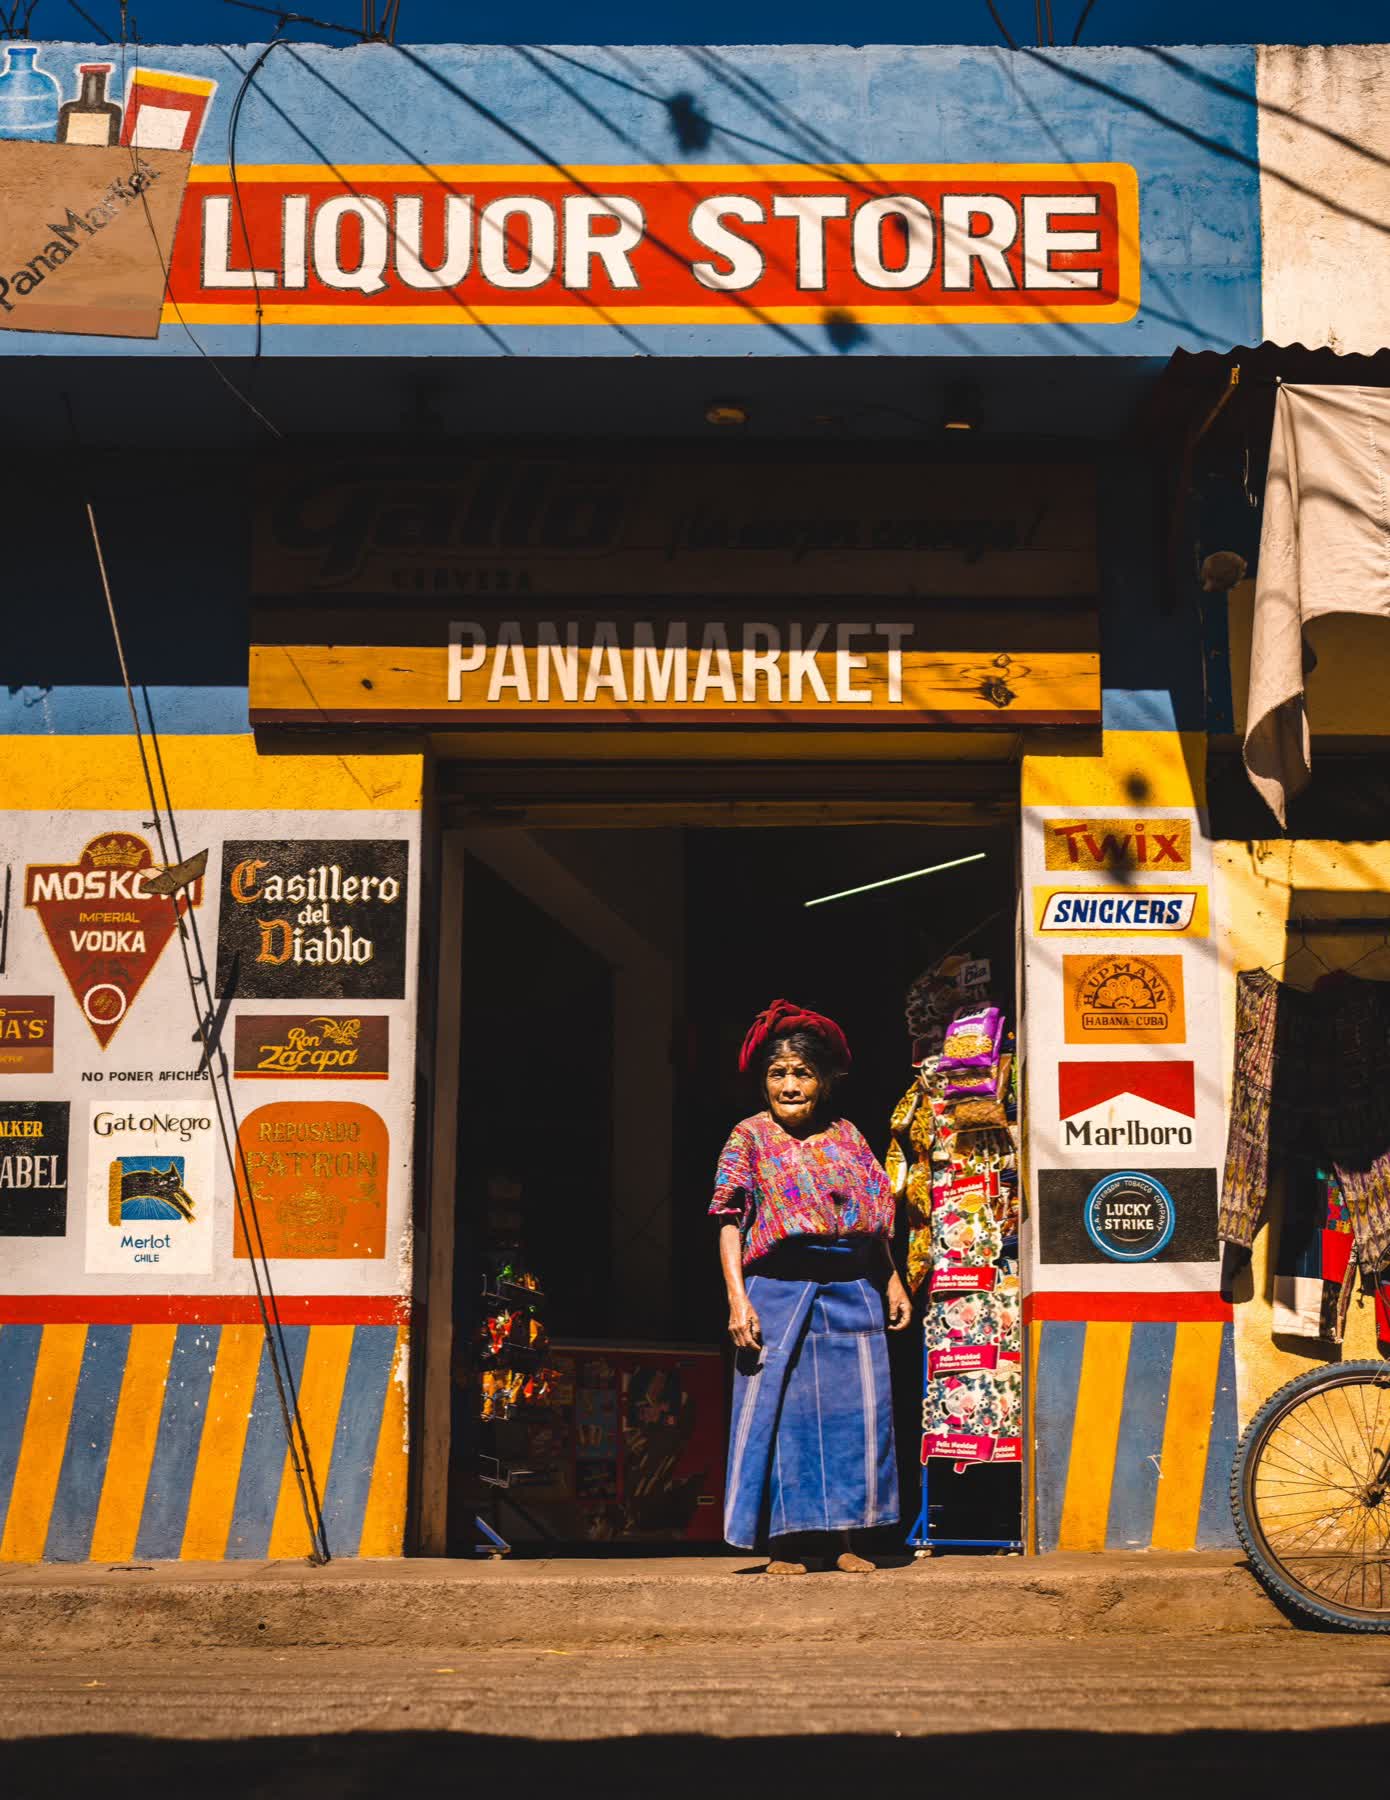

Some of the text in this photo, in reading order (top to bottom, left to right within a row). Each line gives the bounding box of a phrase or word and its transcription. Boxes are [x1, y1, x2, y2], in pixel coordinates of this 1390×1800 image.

[201, 193, 1103, 296] LIQUOR STORE
[448, 621, 914, 703] PANAMARKET
[230, 859, 400, 904] Casillero
[79, 912, 141, 923] IMPERIAL
[297, 903, 330, 925] del
[1054, 900, 1183, 924] SNICKERS
[70, 931, 146, 952] VODKA
[256, 918, 374, 966] Diablo
[287, 1028, 321, 1051] Ron
[257, 1046, 359, 1072] Zacapa
[81, 1070, 209, 1082] NO PONER AFICHES
[259, 1122, 361, 1142] REPOSADO
[1065, 1120, 1193, 1146] Marlboro
[1105, 1203, 1152, 1216] LUCKY
[1124, 1180, 1153, 1194] TOBACCO
[1153, 1195, 1166, 1232] COMPANY
[1104, 1218, 1154, 1230] STRIKE
[120, 1234, 171, 1249] Merlot
[134, 1254, 160, 1263] CHILE
